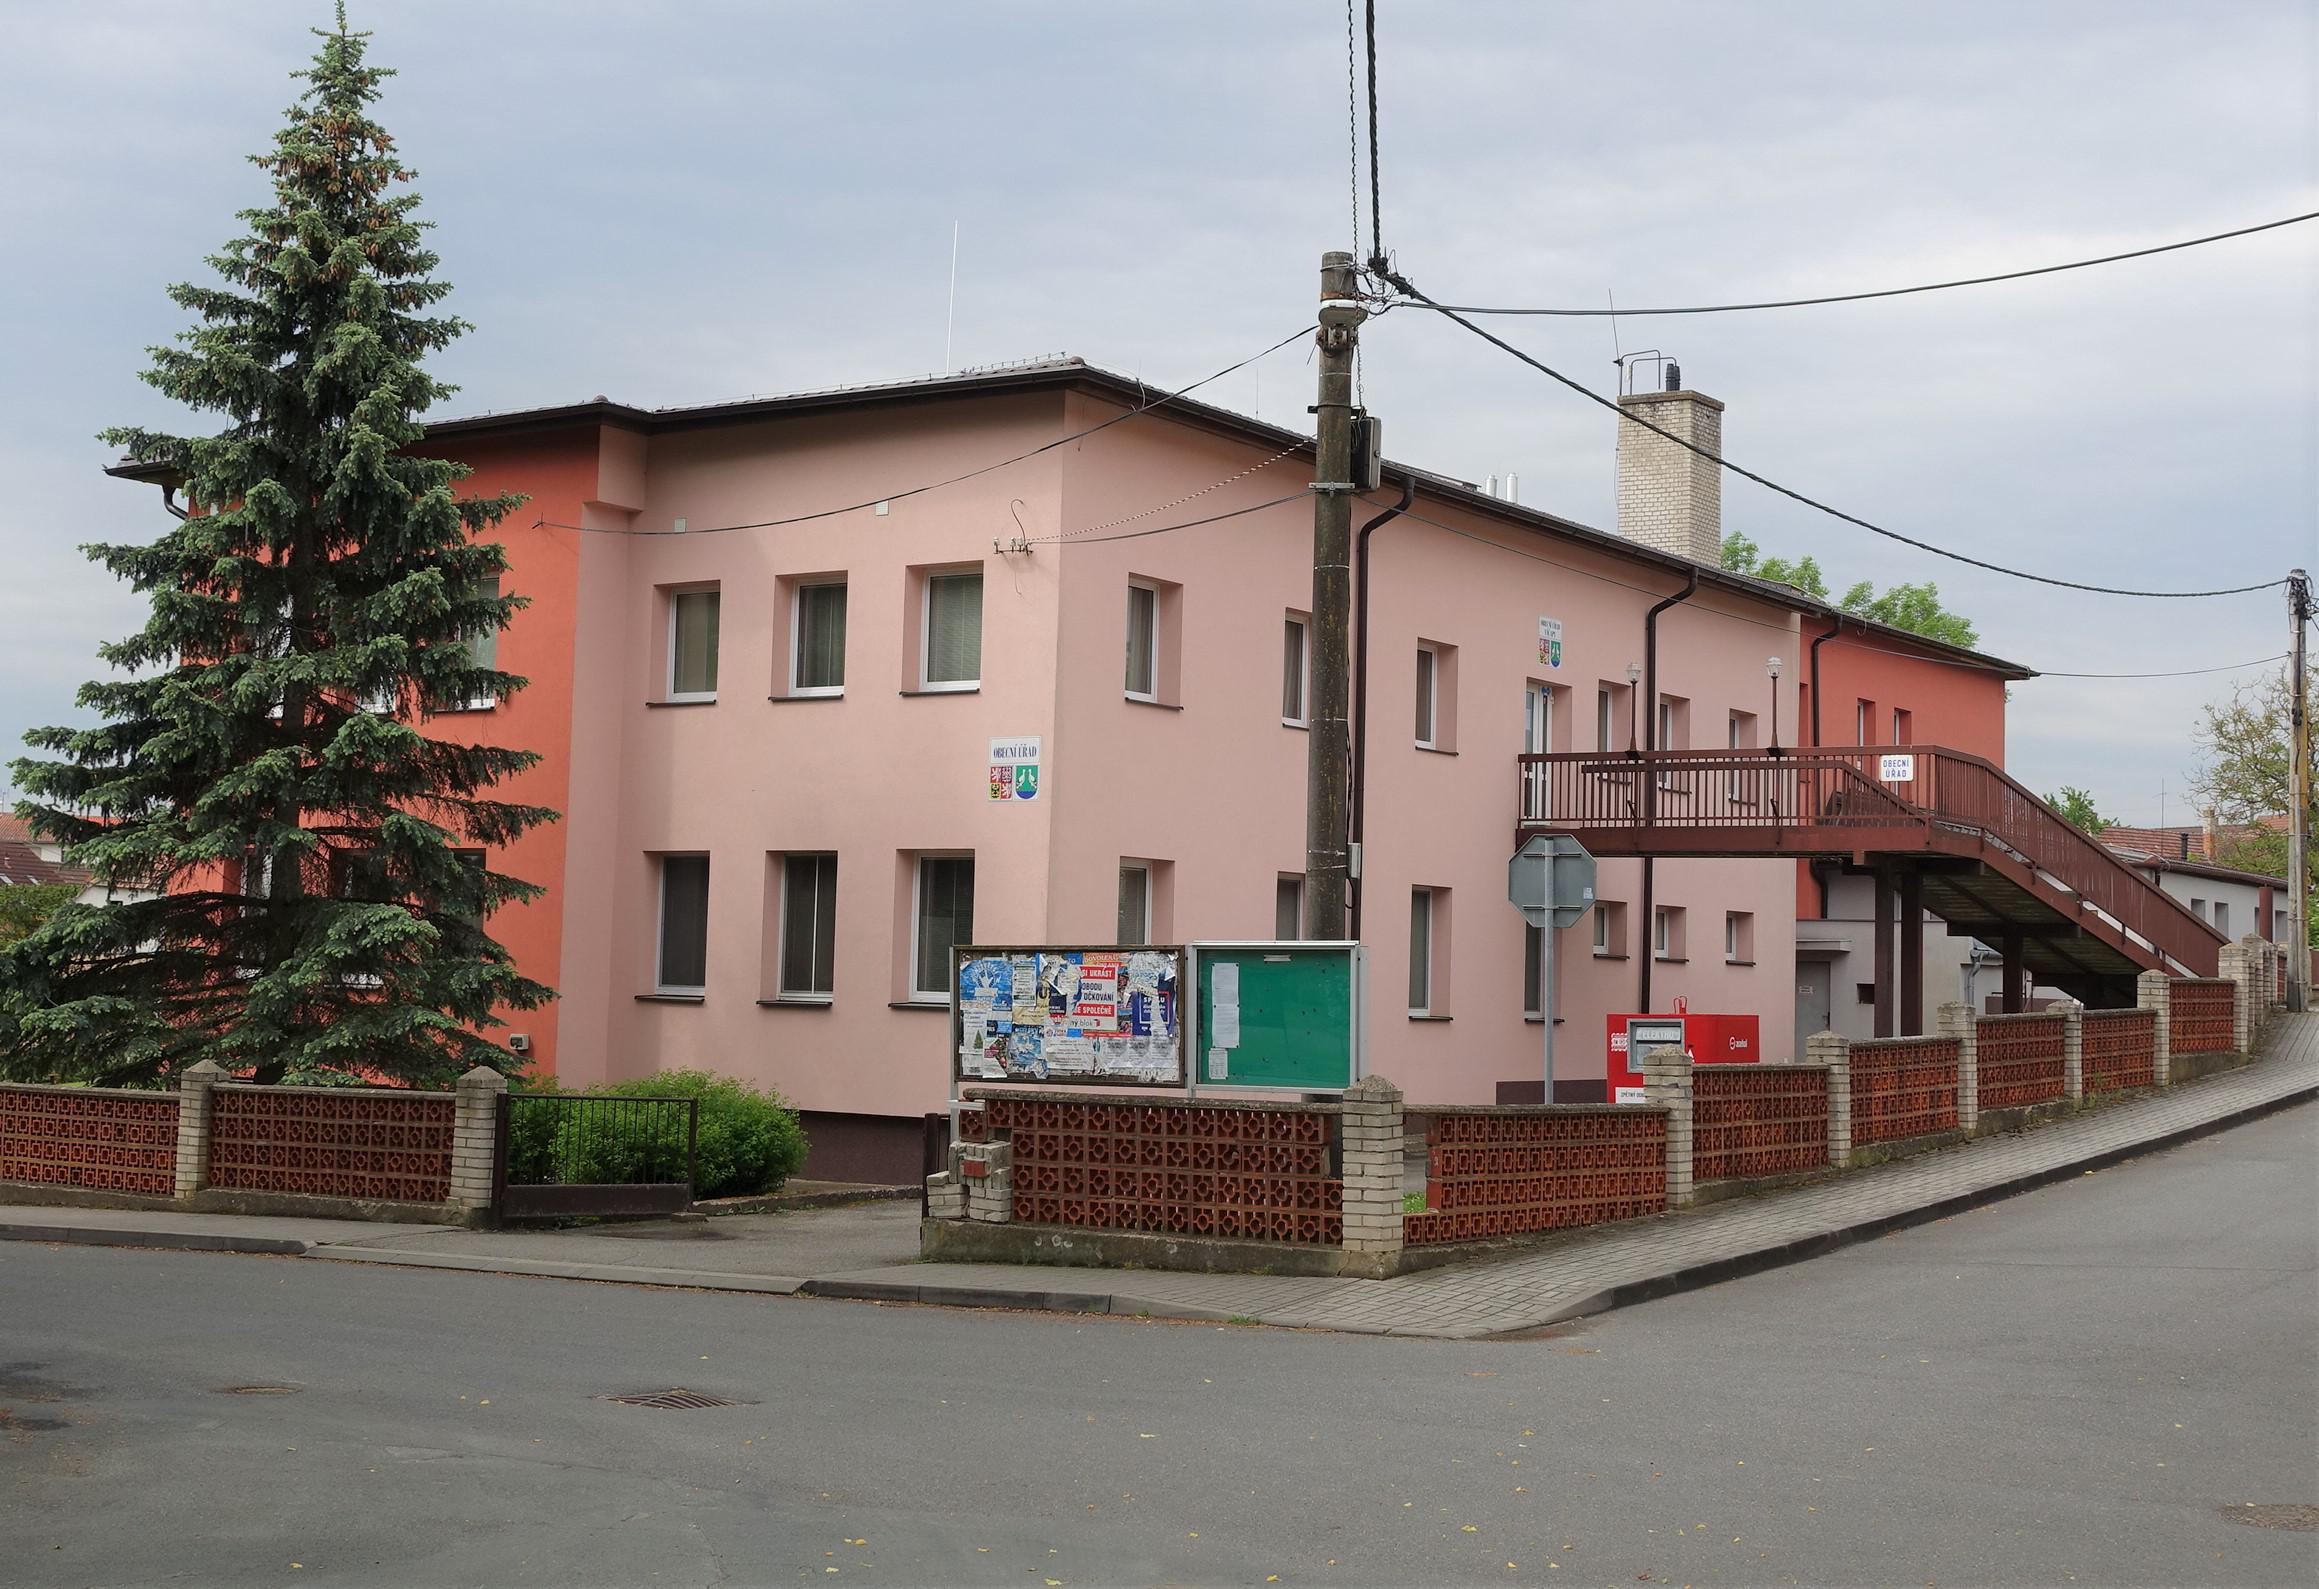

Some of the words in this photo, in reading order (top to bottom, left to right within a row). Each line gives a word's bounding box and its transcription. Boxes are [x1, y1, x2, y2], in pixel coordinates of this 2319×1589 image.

[993, 744, 1017, 758] OBECNÍ
[1018, 743, 1037, 758] ÚŘAD
[1883, 757, 1909, 767] OBECNÍ
[1885, 767, 1907, 778] ÚŘAD
[1089, 967, 1113, 977] UKRÁST
[1082, 1005, 1112, 1014] SPOLEČNĚ
